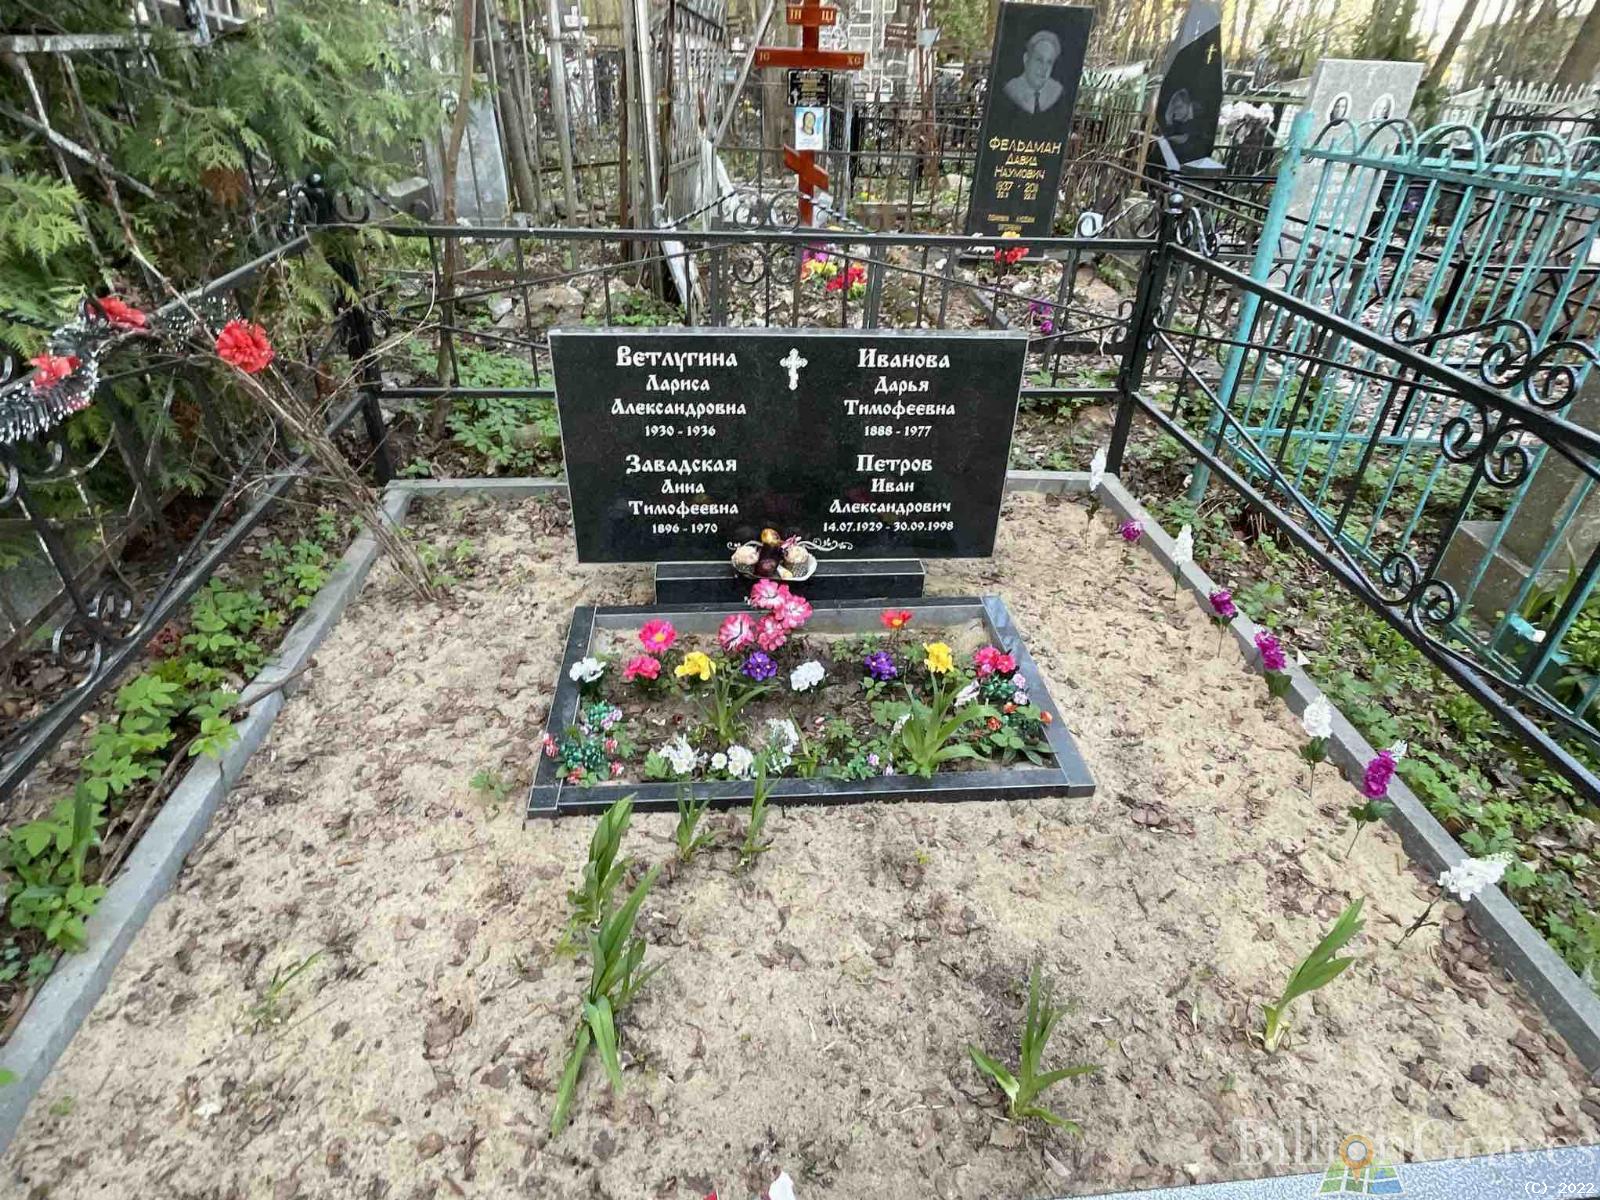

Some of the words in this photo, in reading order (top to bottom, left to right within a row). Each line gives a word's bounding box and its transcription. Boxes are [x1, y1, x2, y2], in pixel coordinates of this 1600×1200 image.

[988, 135, 1062, 154] ФЕЛЬДМАН
[616, 345, 738, 373] Ветлугина
[857, 348, 950, 368] Иванова
[646, 374, 710, 395] Лариса
[874, 375, 929, 395] Дарья
[611, 398, 747, 419] Александровна
[844, 400, 956, 419] Тимофеевна
[645, 425, 675, 437] 1930
[687, 425, 716, 437] 1936
[864, 426, 893, 437] 1888
[904, 426, 932, 437] 1977
[625, 454, 737, 475] Завадская
[856, 454, 933, 476] Петров
[661, 479, 705, 494] Анна
[870, 478, 914, 493] Иван
[628, 500, 739, 518] Тимофеевна
[829, 499, 951, 516] Александрович
[652, 523, 680, 534] 1896
[691, 523, 718, 534] 1970
[823, 521, 883, 532] 14.07.1929
[893, 521, 954, 531] 30.09.1998
